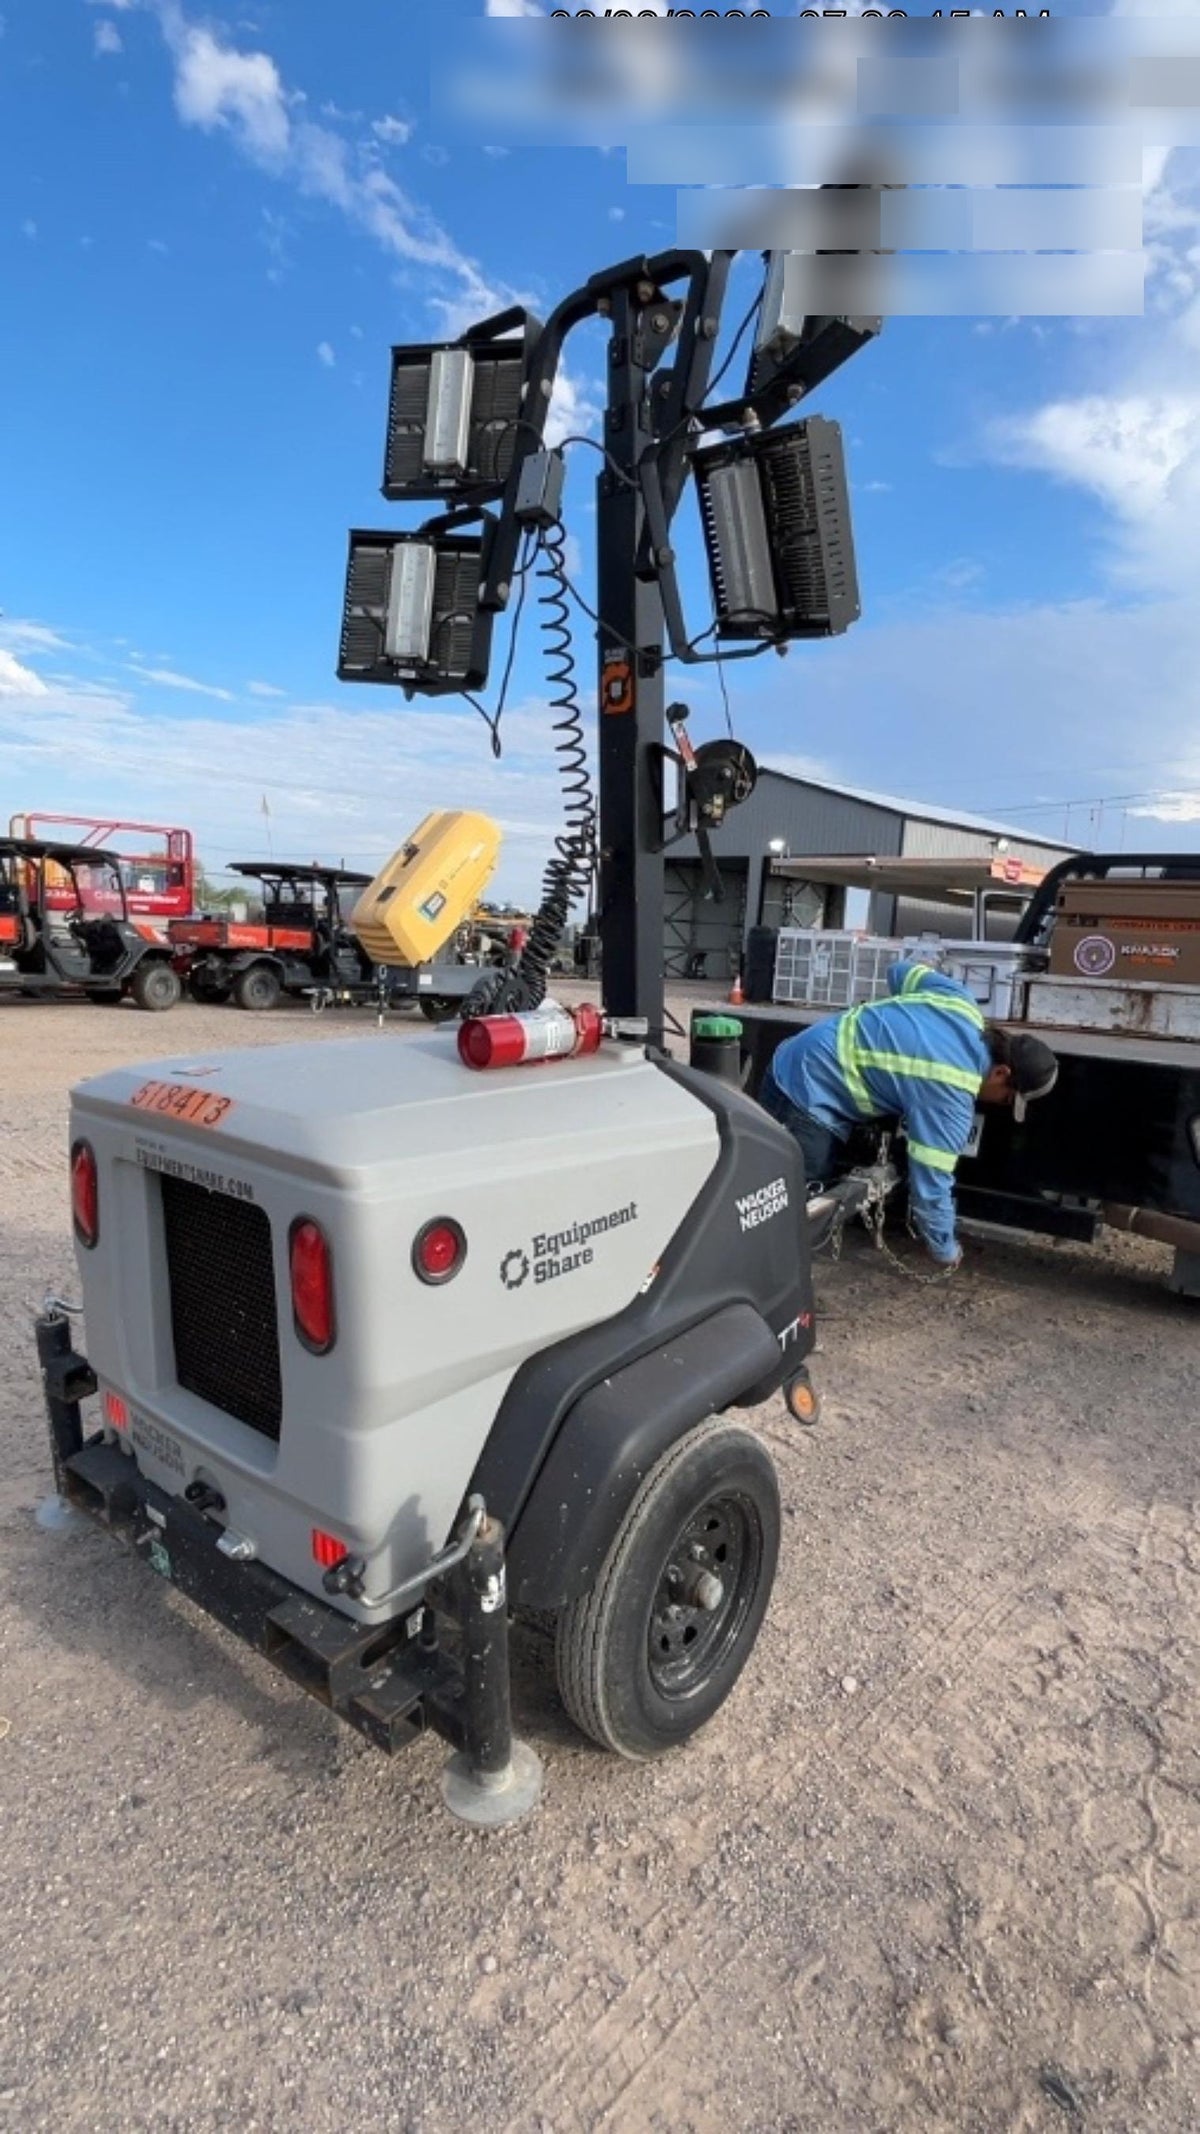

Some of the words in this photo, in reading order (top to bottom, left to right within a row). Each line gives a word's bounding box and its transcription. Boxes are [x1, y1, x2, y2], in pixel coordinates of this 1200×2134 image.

[131, 1080, 232, 1125] 518413
[735, 1177, 786, 1215] WACKER
[739, 1192, 788, 1233] NEUSON
[532, 1201, 638, 1258] Equipment
[534, 1247, 594, 1284] Share
